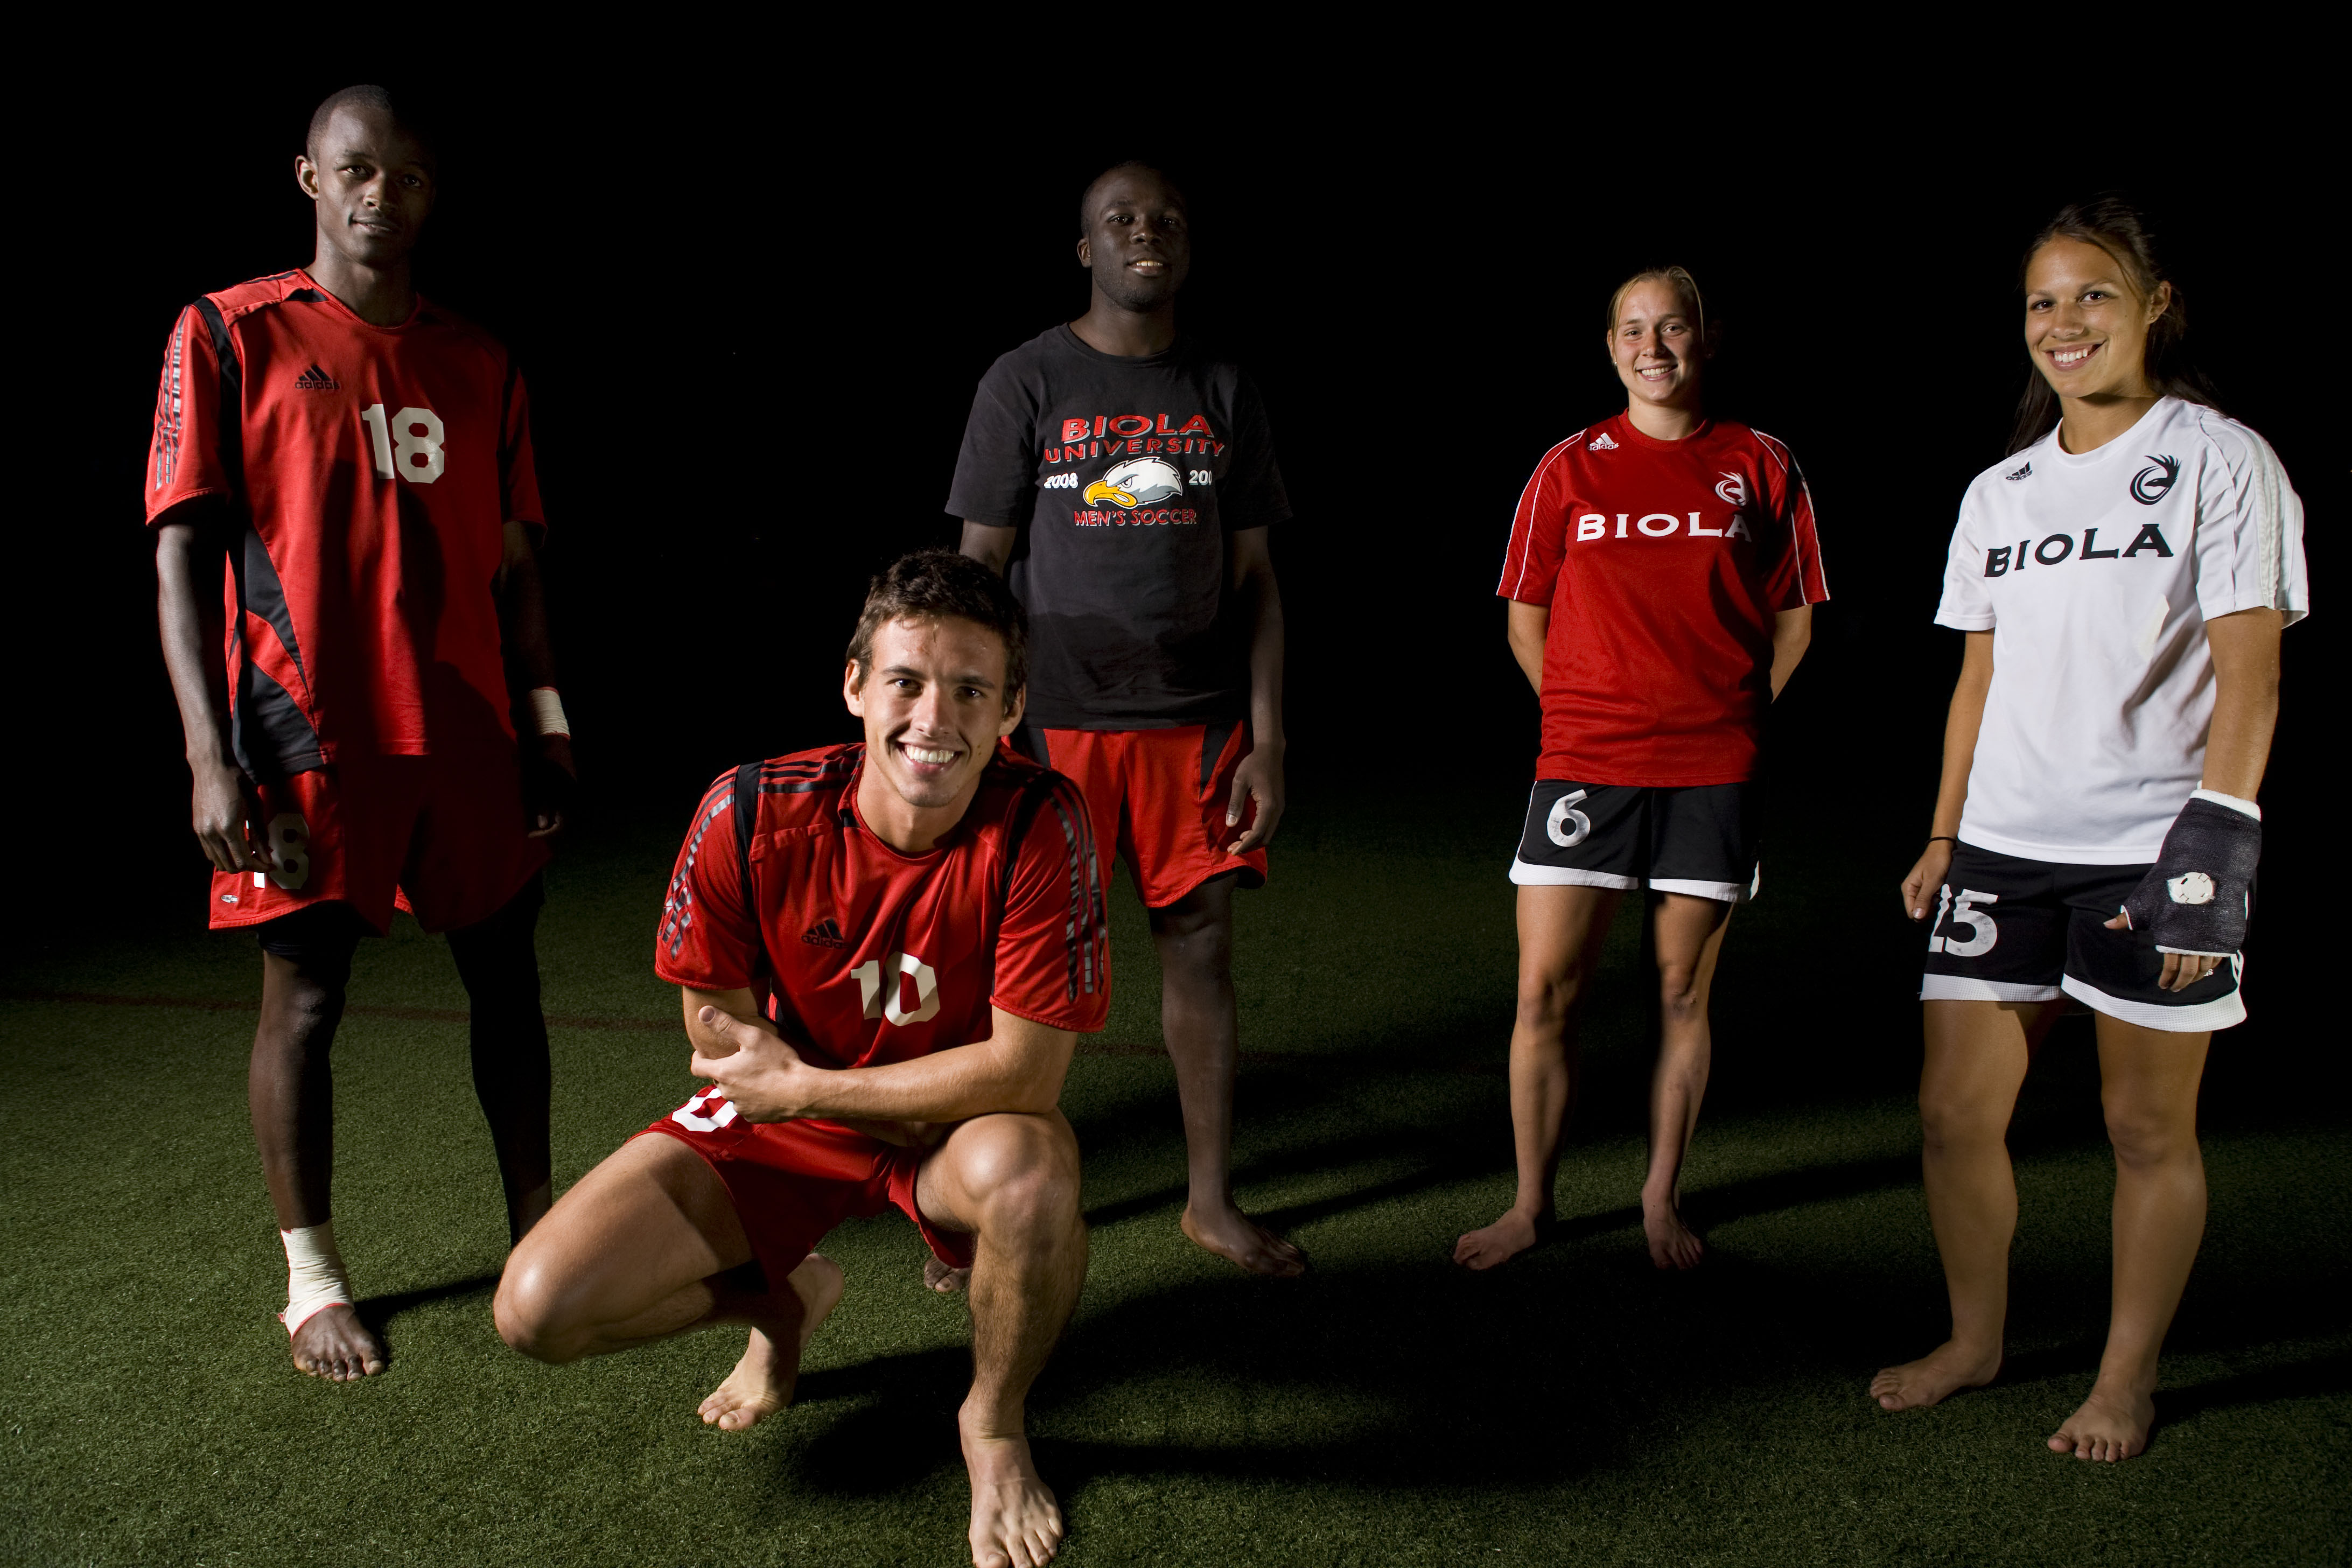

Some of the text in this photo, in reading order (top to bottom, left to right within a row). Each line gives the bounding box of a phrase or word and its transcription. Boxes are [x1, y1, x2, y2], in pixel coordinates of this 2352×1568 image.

[295, 380, 340, 389] adidas
[361, 403, 444, 484] 18
[1061, 414, 1214, 444] BIOLA
[1045, 438, 1224, 464] UNIVERSITY
[1587, 443, 1619, 451] adidas
[1044, 472, 1079, 488] 2008
[2006, 470, 2033, 480] adidas
[1074, 508, 1197, 526] MEN'S SOCCER
[1577, 512, 1752, 542] BIOLA
[1984, 523, 2173, 577] BIOLA
[1546, 789, 1591, 847] 6
[247, 813, 310, 890] 8
[850, 951, 941, 1026] 10
